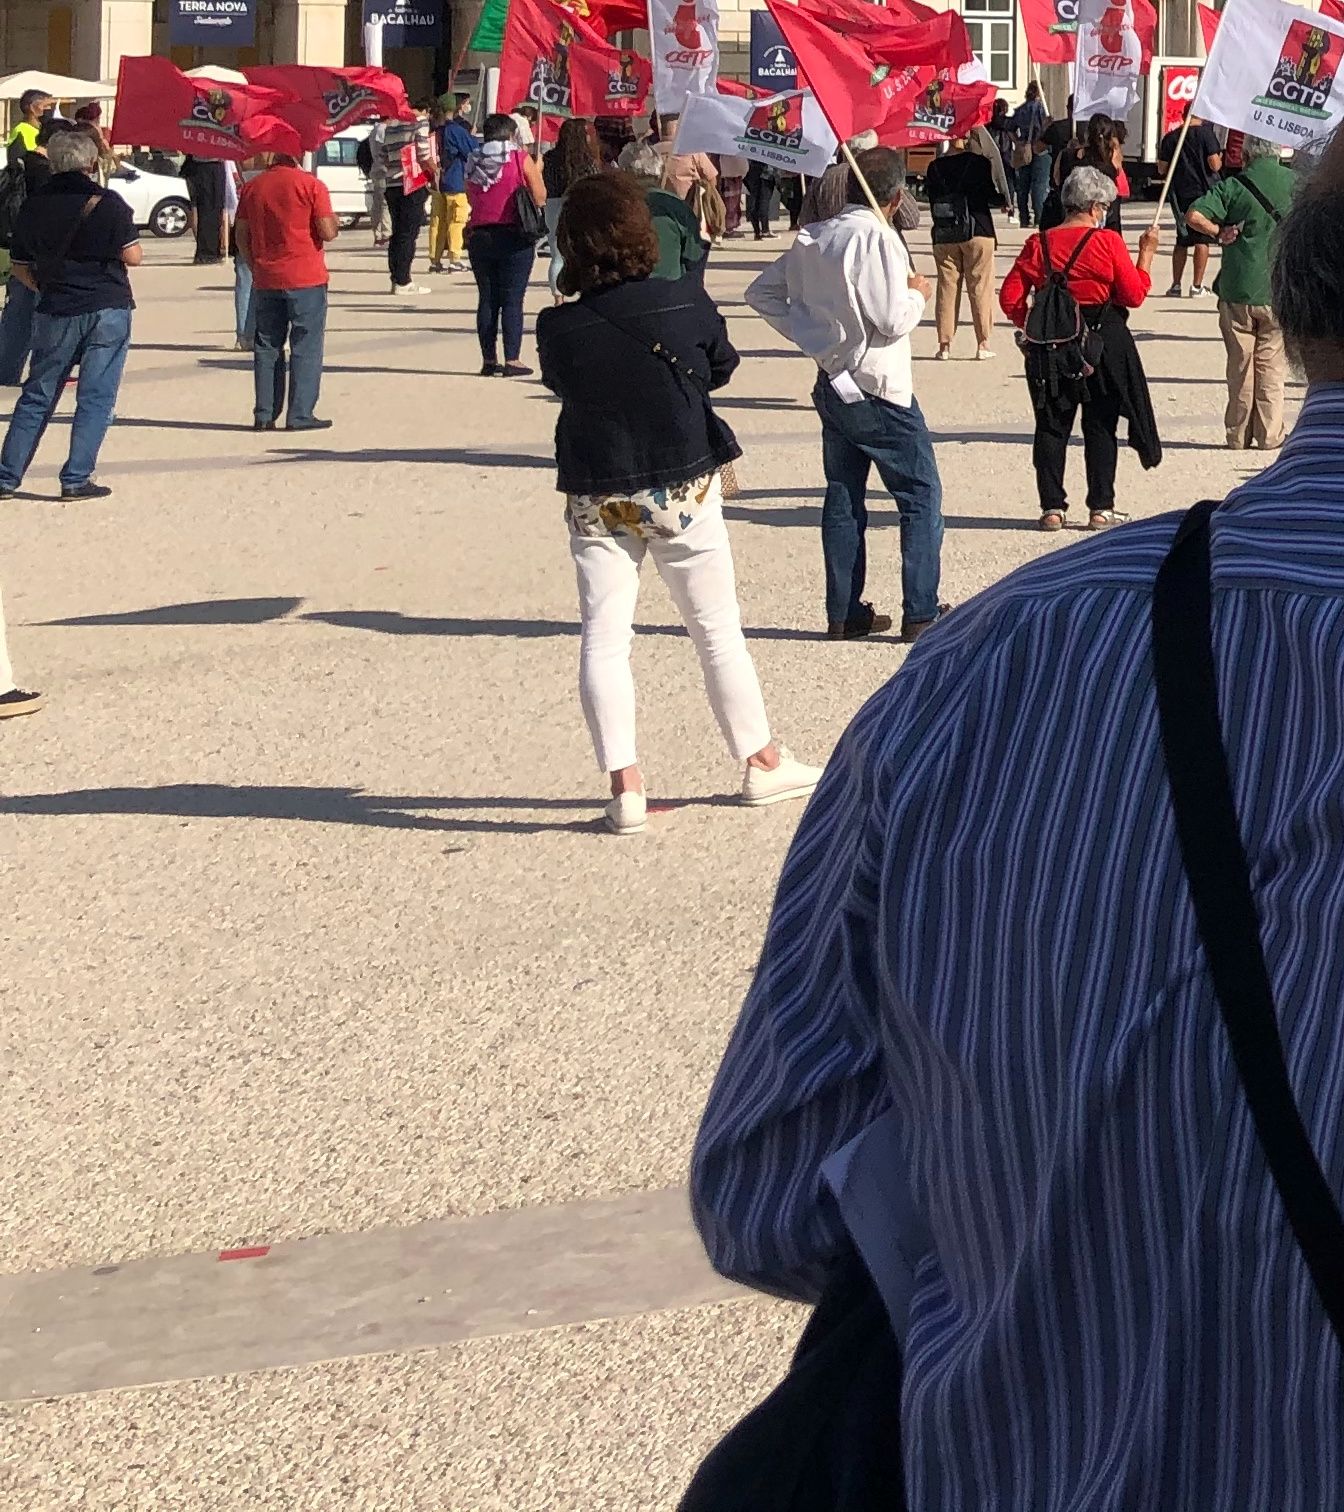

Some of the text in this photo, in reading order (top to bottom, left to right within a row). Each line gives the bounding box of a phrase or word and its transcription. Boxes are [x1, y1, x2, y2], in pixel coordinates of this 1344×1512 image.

[178, 0, 248, 12] TERRA NOVA
[371, 12, 435, 26] BACALHAU
[664, 50, 714, 67] CGTP
[1088, 54, 1134, 70] CGTP
[758, 67, 797, 77] BACALHA
[530, 81, 571, 106] CGT
[608, 81, 638, 93] CGTP
[1268, 77, 1326, 108] CGTP
[746, 126, 801, 148] CGTP
[1277, 118, 1314, 139] LISBOA
[761, 148, 797, 165] LISBOA
